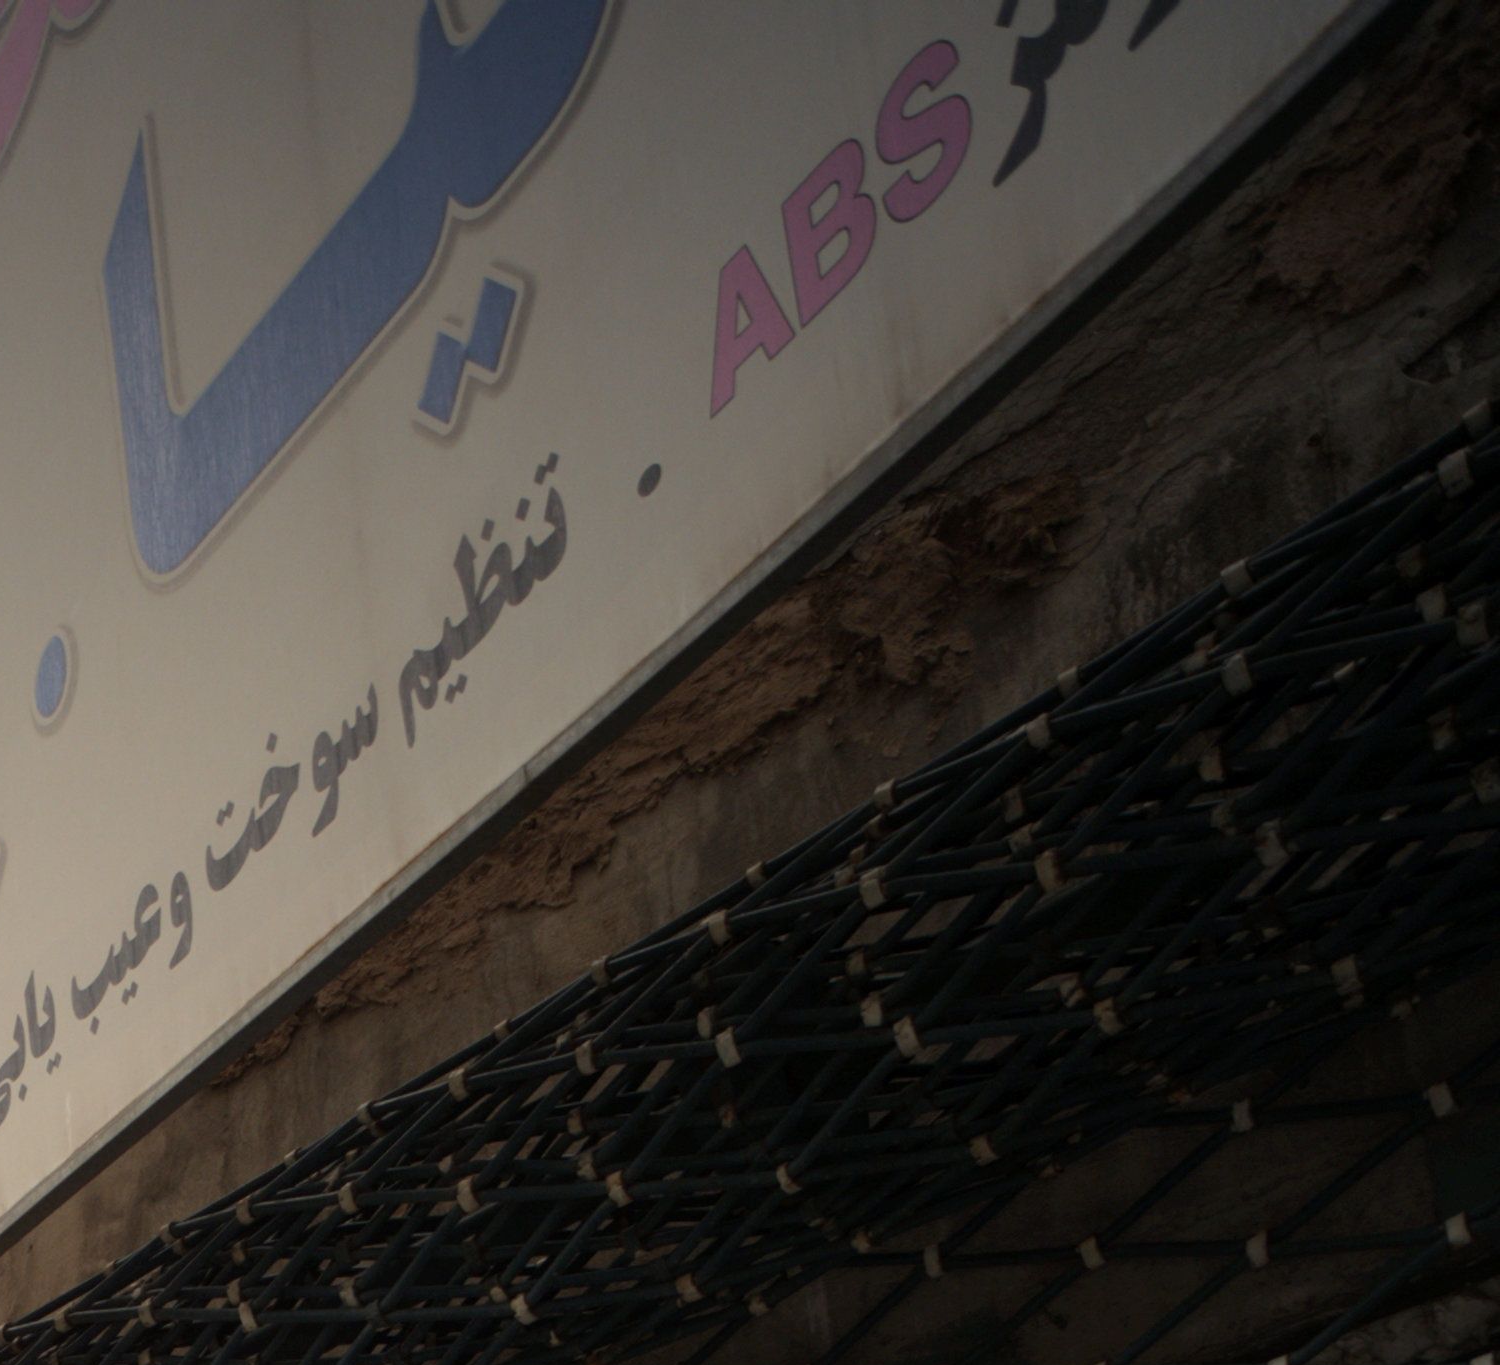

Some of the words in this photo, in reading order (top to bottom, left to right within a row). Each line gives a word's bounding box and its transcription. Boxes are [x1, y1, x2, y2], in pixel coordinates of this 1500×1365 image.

[710, 39, 972, 419] ABS
[398, 452, 567, 748] تنظیم
[205, 683, 378, 891] سوخت
